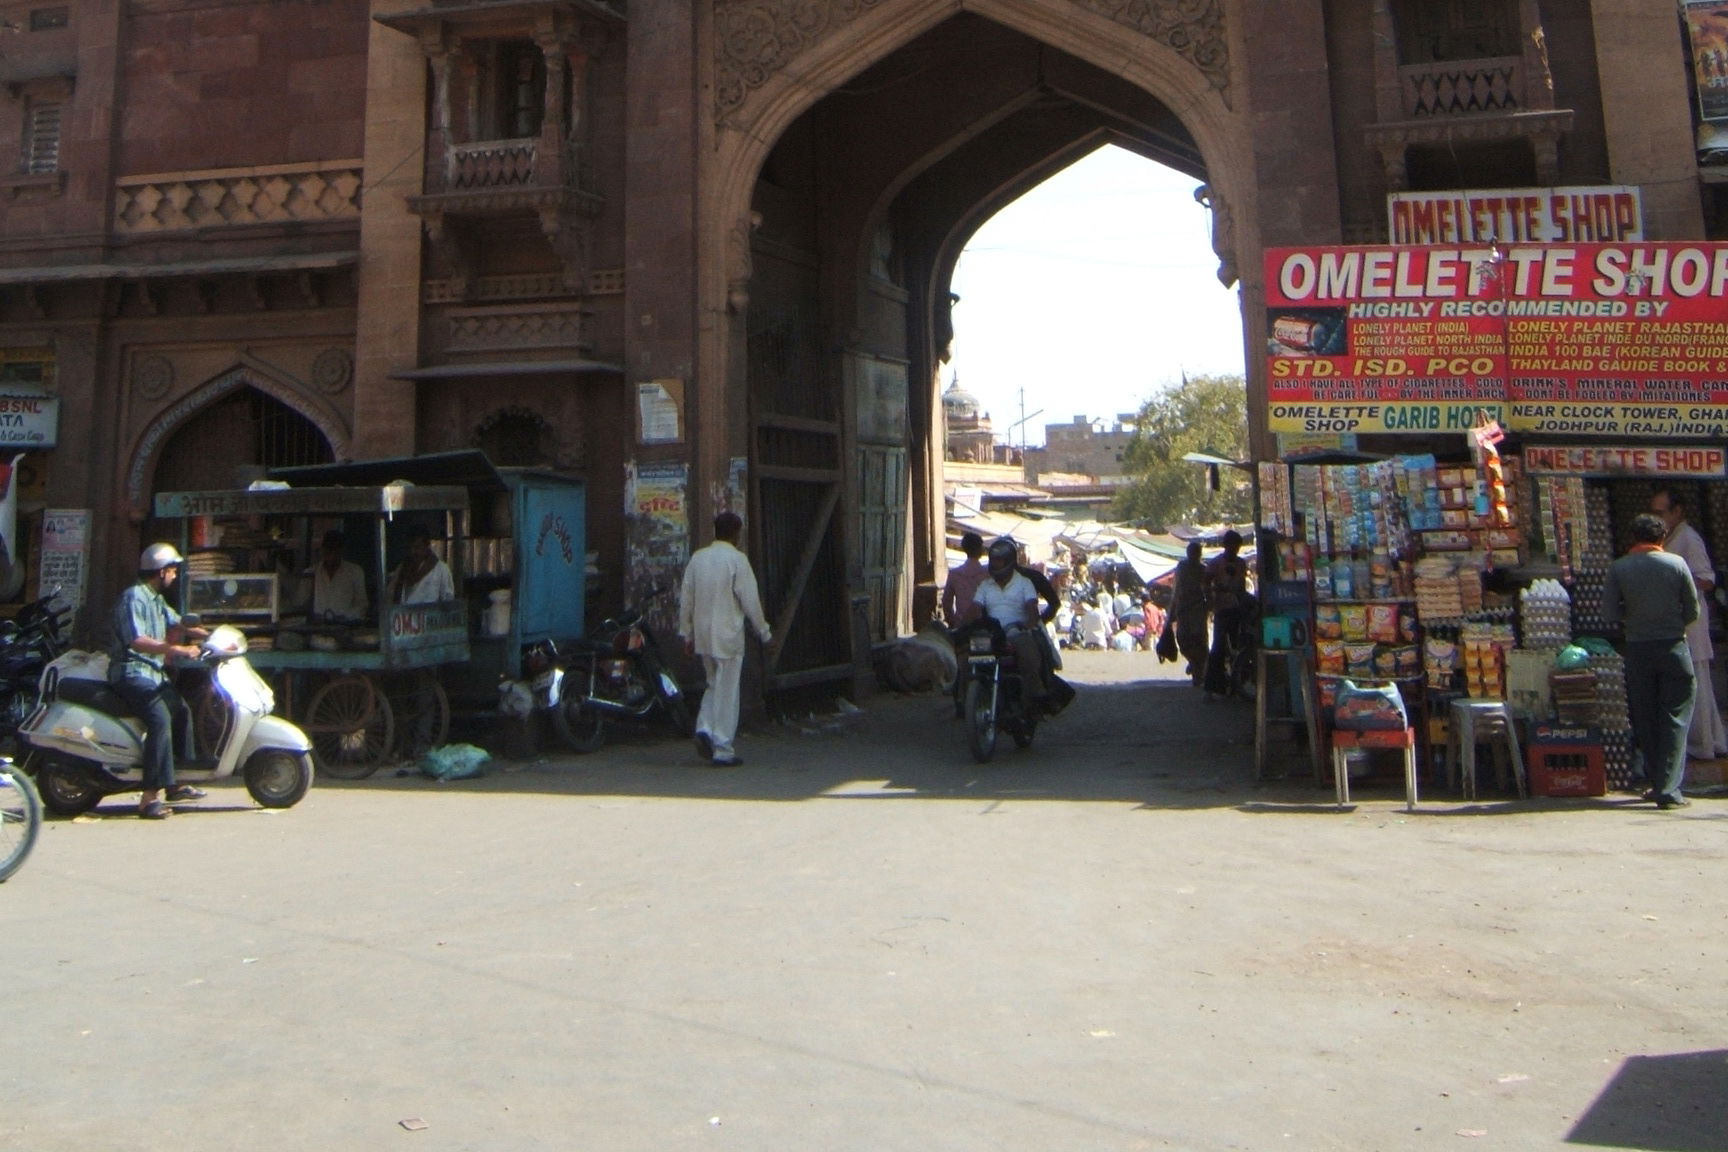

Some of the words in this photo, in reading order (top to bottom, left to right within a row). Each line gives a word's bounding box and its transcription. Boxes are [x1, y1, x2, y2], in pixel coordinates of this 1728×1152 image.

[1392, 196, 1542, 244] OMELETTE
[1551, 193, 1638, 243] SHOP
[1279, 249, 1576, 300] OMELETTE
[1348, 301, 1435, 318] HIGHLY
[1440, 300, 1628, 317] RECOMMENDED
[1634, 301, 1669, 317] BY
[1353, 323, 1391, 334] LONELY
[1393, 322, 1432, 334] PLANET
[1435, 321, 1469, 334] (INDIA)
[1509, 321, 1568, 333] LONELY
[1573, 322, 1636, 333] PLANET
[1640, 322, 1728, 334] RAJASTHA
[1353, 335, 1392, 346] LONELY
[1394, 335, 1433, 345] PLANET
[1436, 334, 1471, 344] NORTH
[1474, 334, 1503, 344] INDIA
[1509, 333, 1553, 343] LONELY
[1556, 334, 1600, 344] PLANET
[1604, 334, 1632, 344] INDE
[1636, 334, 1652, 344] DU
[1354, 346, 1372, 356] THE
[1374, 346, 1405, 356] ROUGH
[1407, 346, 1435, 355] GUIDE
[1439, 346, 1450, 355] TO
[1452, 345, 1505, 356] RAJASTHAN
[1510, 344, 1548, 355] INDIA
[1555, 345, 1578, 356] 100
[1582, 345, 1611, 357] BAE
[1615, 346, 1680, 359] (KOREAN
[1272, 359, 1341, 377] STD.
[1354, 359, 1414, 376] ISD.
[1426, 358, 1494, 376] PCO
[1511, 359, 1594, 370] THAYLAND
[1599, 360, 1658, 371] GAUIDE
[1663, 361, 1710, 372] BOOK
[1274, 379, 1299, 388] ALSO
[1309, 379, 1334, 388] HAVE
[1339, 379, 1355, 388] ALL
[1387, 378, 1399, 387] OF
[1577, 379, 1637, 388] MINERAL
[1418, 389, 1436, 398] THE
[1384, 405, 1440, 429] GARIB
[1512, 405, 1556, 417] NEAR
[1561, 406, 1615, 418] CLOCK
[1621, 407, 1683, 421] TOWER,
[1304, 419, 1359, 431] SHOP
[1535, 420, 1618, 432] JODHPUR
[1655, 450, 1722, 473] SHOP
